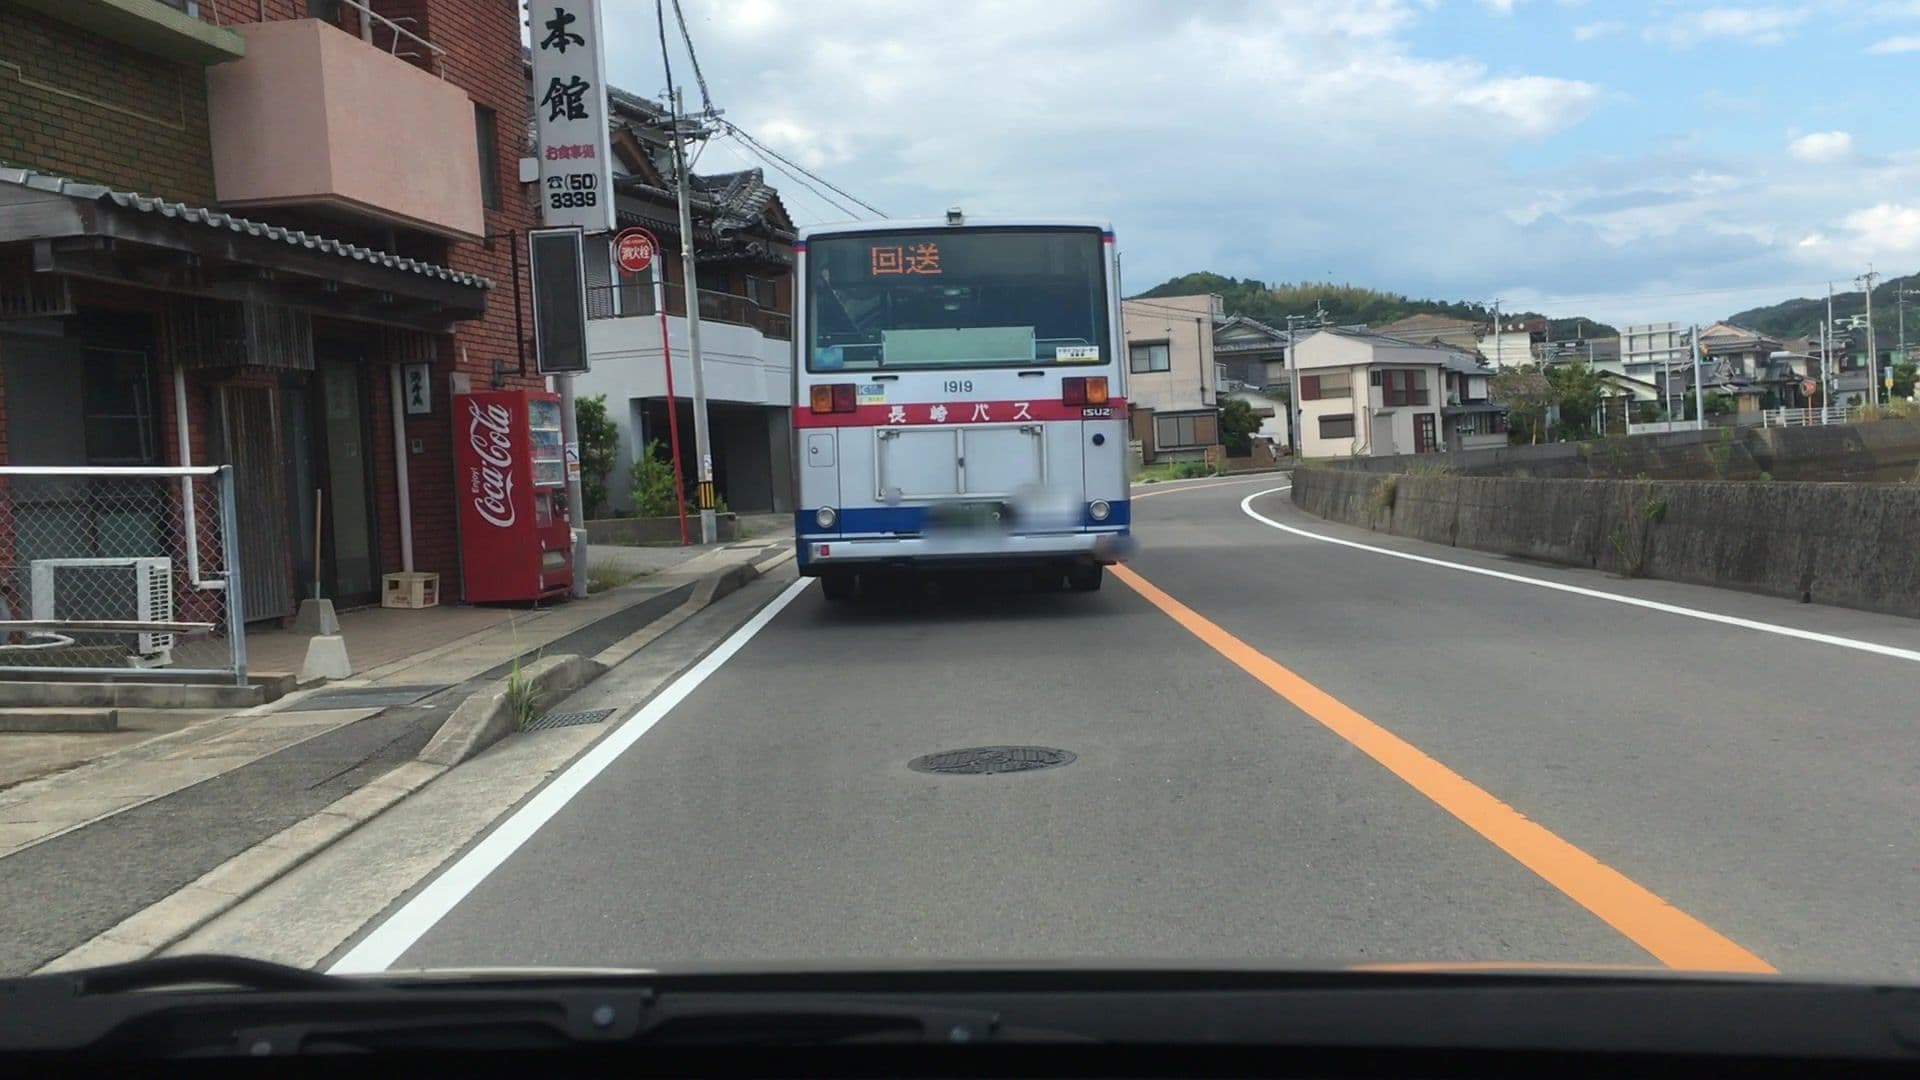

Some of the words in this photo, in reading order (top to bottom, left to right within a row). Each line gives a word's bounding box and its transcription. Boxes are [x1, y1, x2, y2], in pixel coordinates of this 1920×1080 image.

[540, 7, 590, 122] 本館
[565, 174, 598, 190] (50)
[551, 192, 596, 209] 3339
[621, 246, 650, 260] 消火栓
[871, 243, 942, 275] 回送
[944, 380, 973, 392] 1919
[471, 467, 480, 493] Enjoy!
